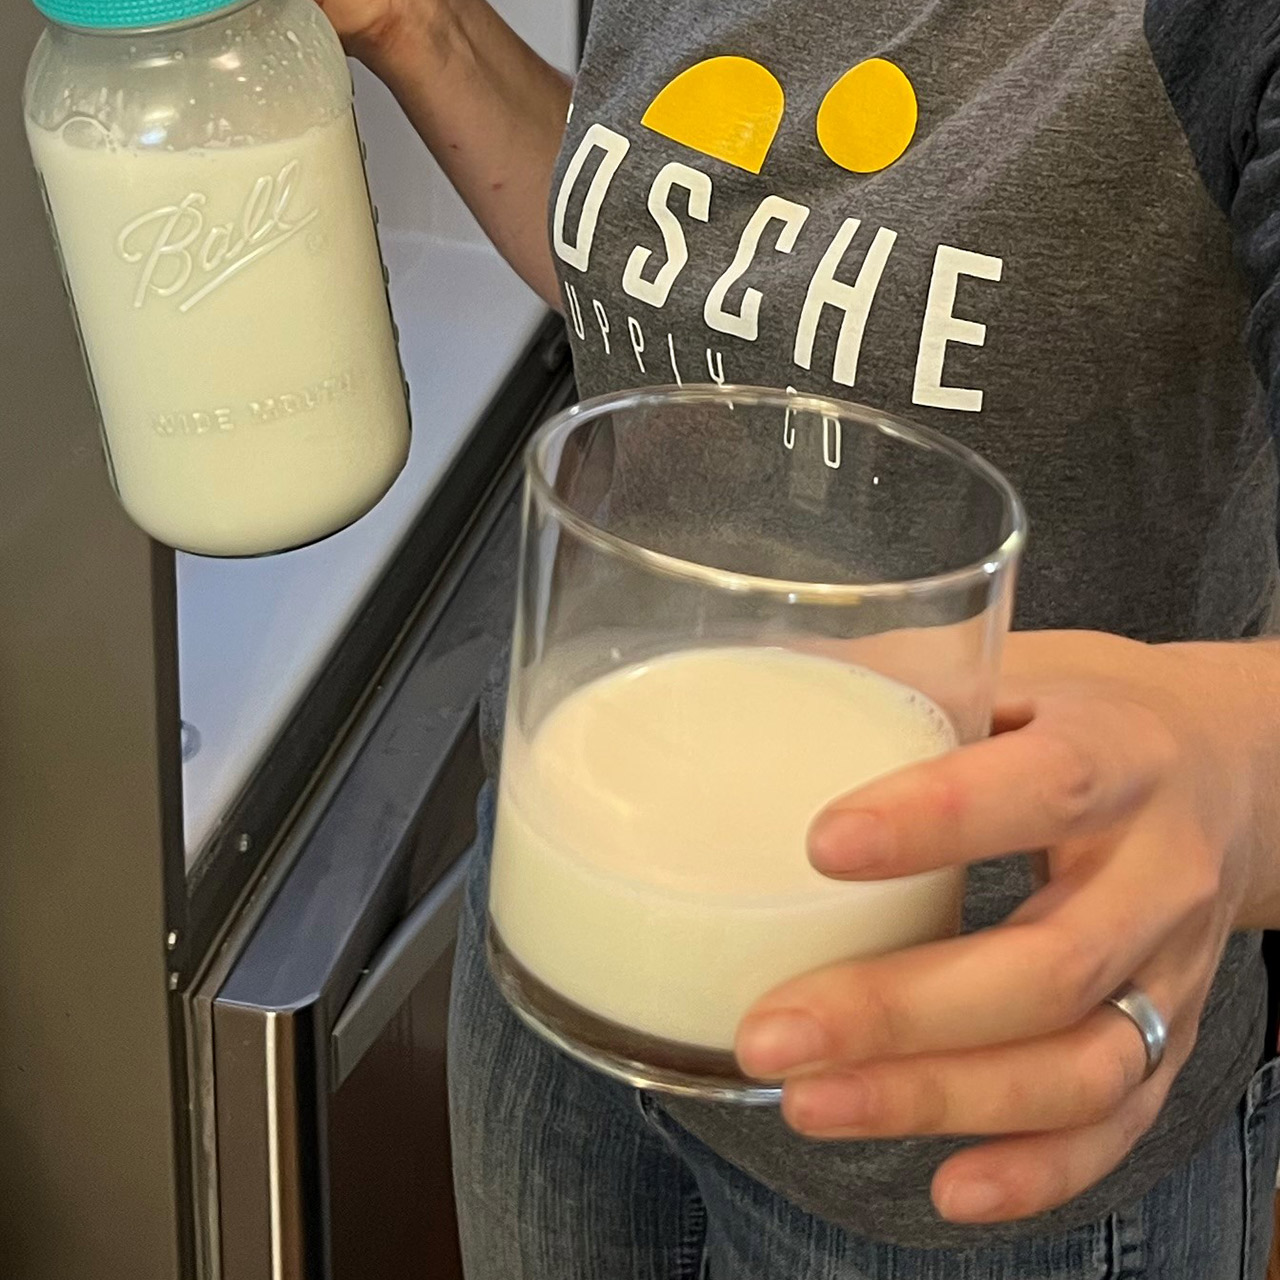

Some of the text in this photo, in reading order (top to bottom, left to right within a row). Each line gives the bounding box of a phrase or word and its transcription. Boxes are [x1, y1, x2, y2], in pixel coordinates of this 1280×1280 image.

[118, 157, 302, 309] Ball
[554, 122, 1004, 413] OSCHE
[564, 281, 734, 410] UPPLY
[153, 406, 235, 435] WIDE
